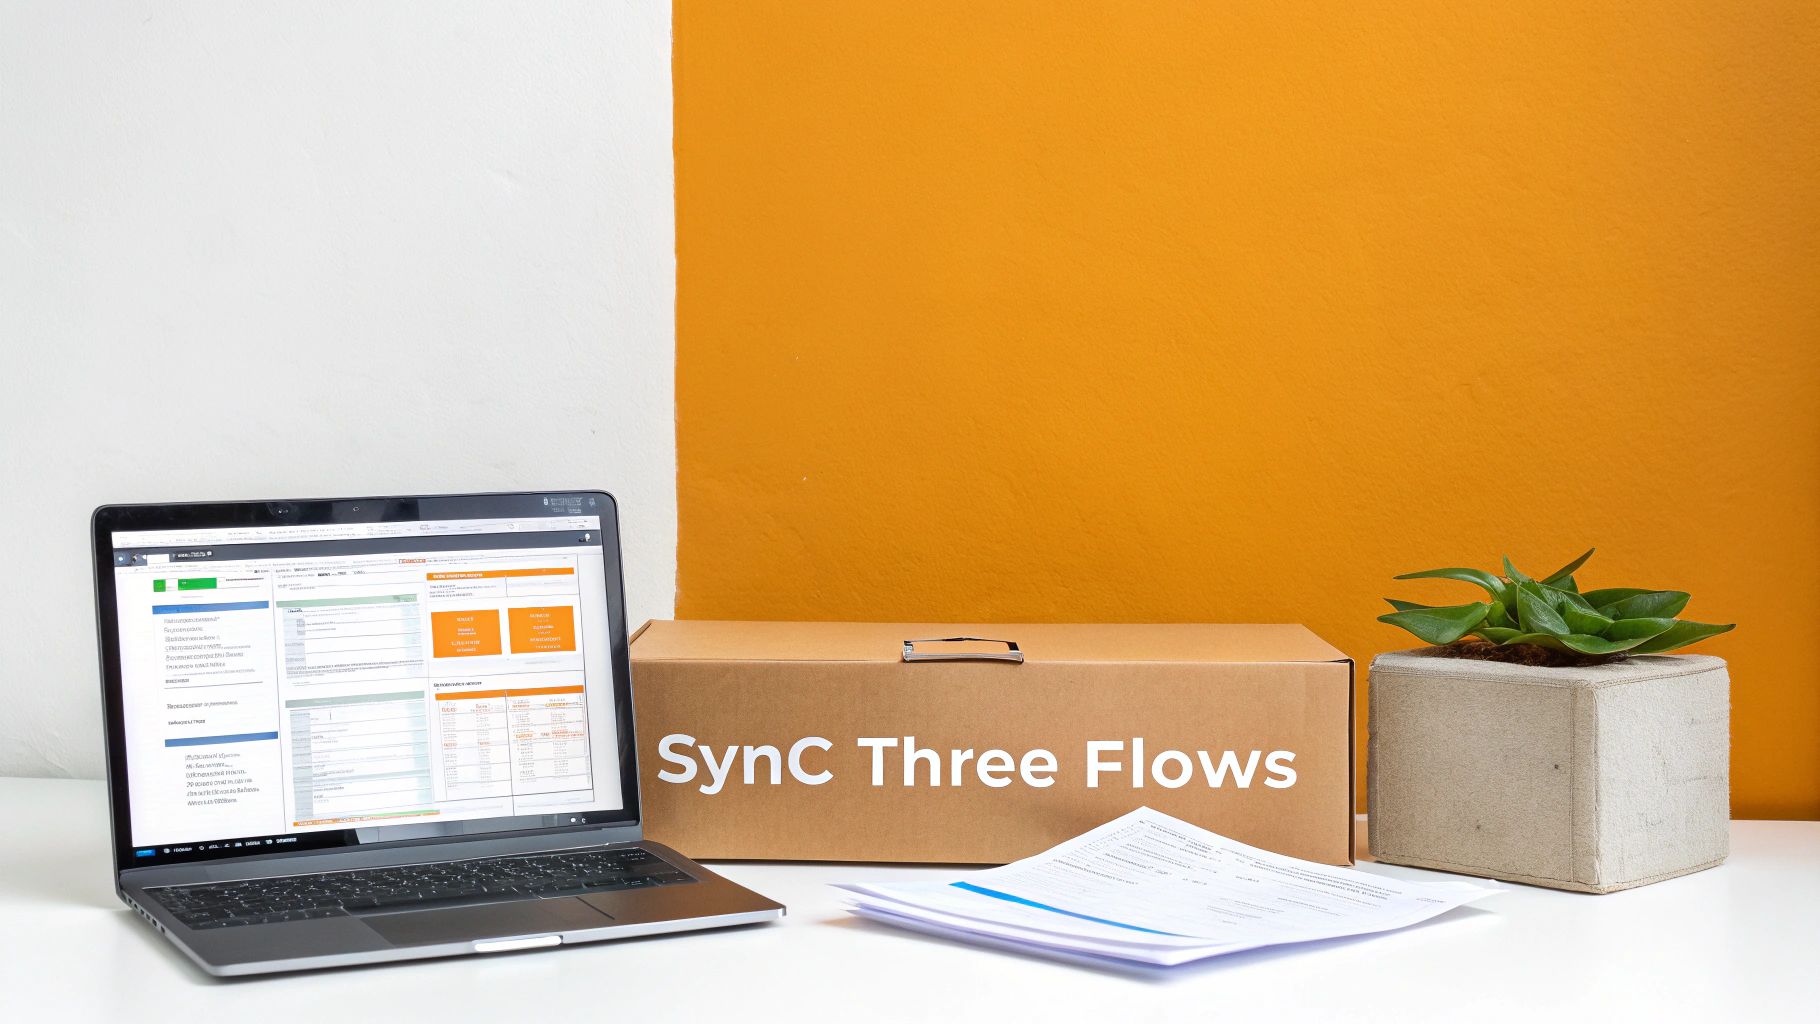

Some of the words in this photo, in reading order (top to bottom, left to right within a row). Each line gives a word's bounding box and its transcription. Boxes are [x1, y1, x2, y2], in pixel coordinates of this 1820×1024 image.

[657, 733, 834, 795] SynC
[857, 736, 1058, 788] Three
[1086, 737, 1298, 789] Flows
